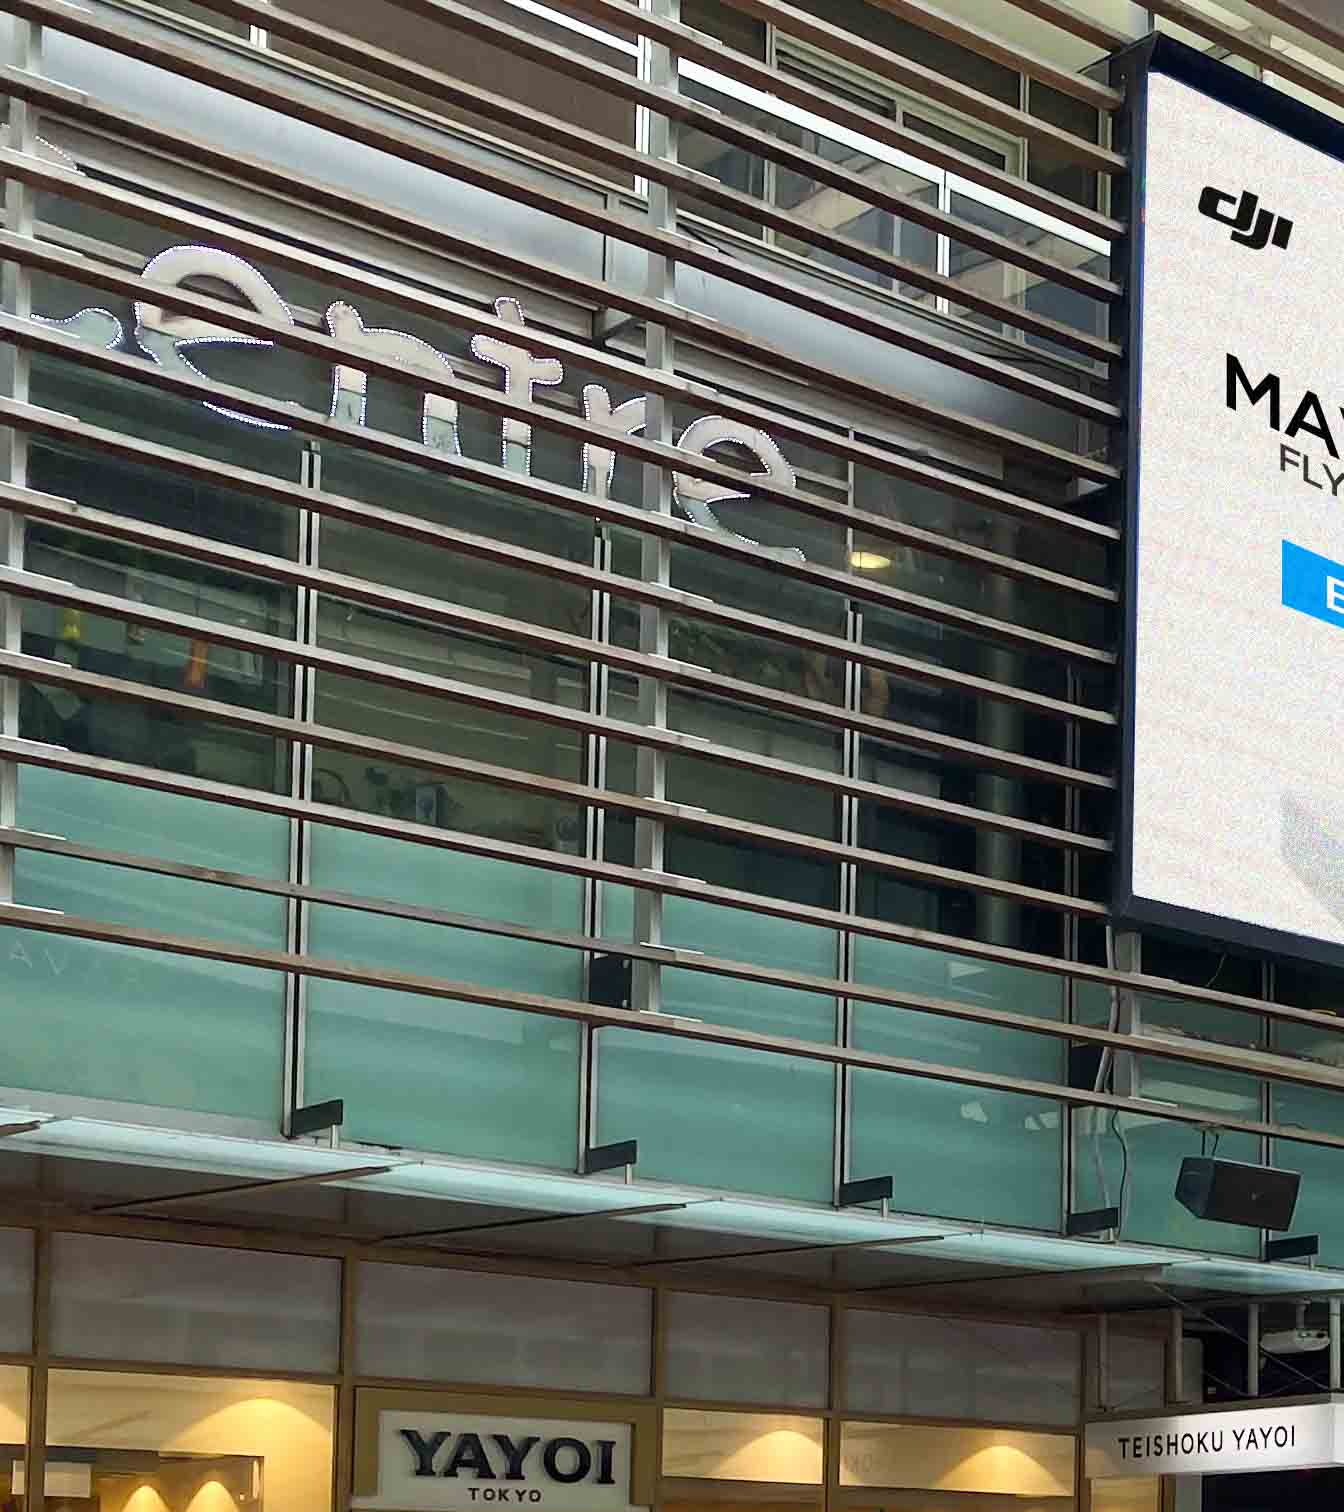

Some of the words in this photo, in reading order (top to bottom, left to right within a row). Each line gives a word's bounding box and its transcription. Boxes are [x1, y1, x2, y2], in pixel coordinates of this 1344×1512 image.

[30, 240, 805, 562] entre
[398, 1429, 616, 1485] YAYOI
[1118, 1430, 1223, 1460] TEISHOKU
[1232, 1424, 1296, 1451] YAYOI
[468, 1487, 542, 1503] TOKYO
